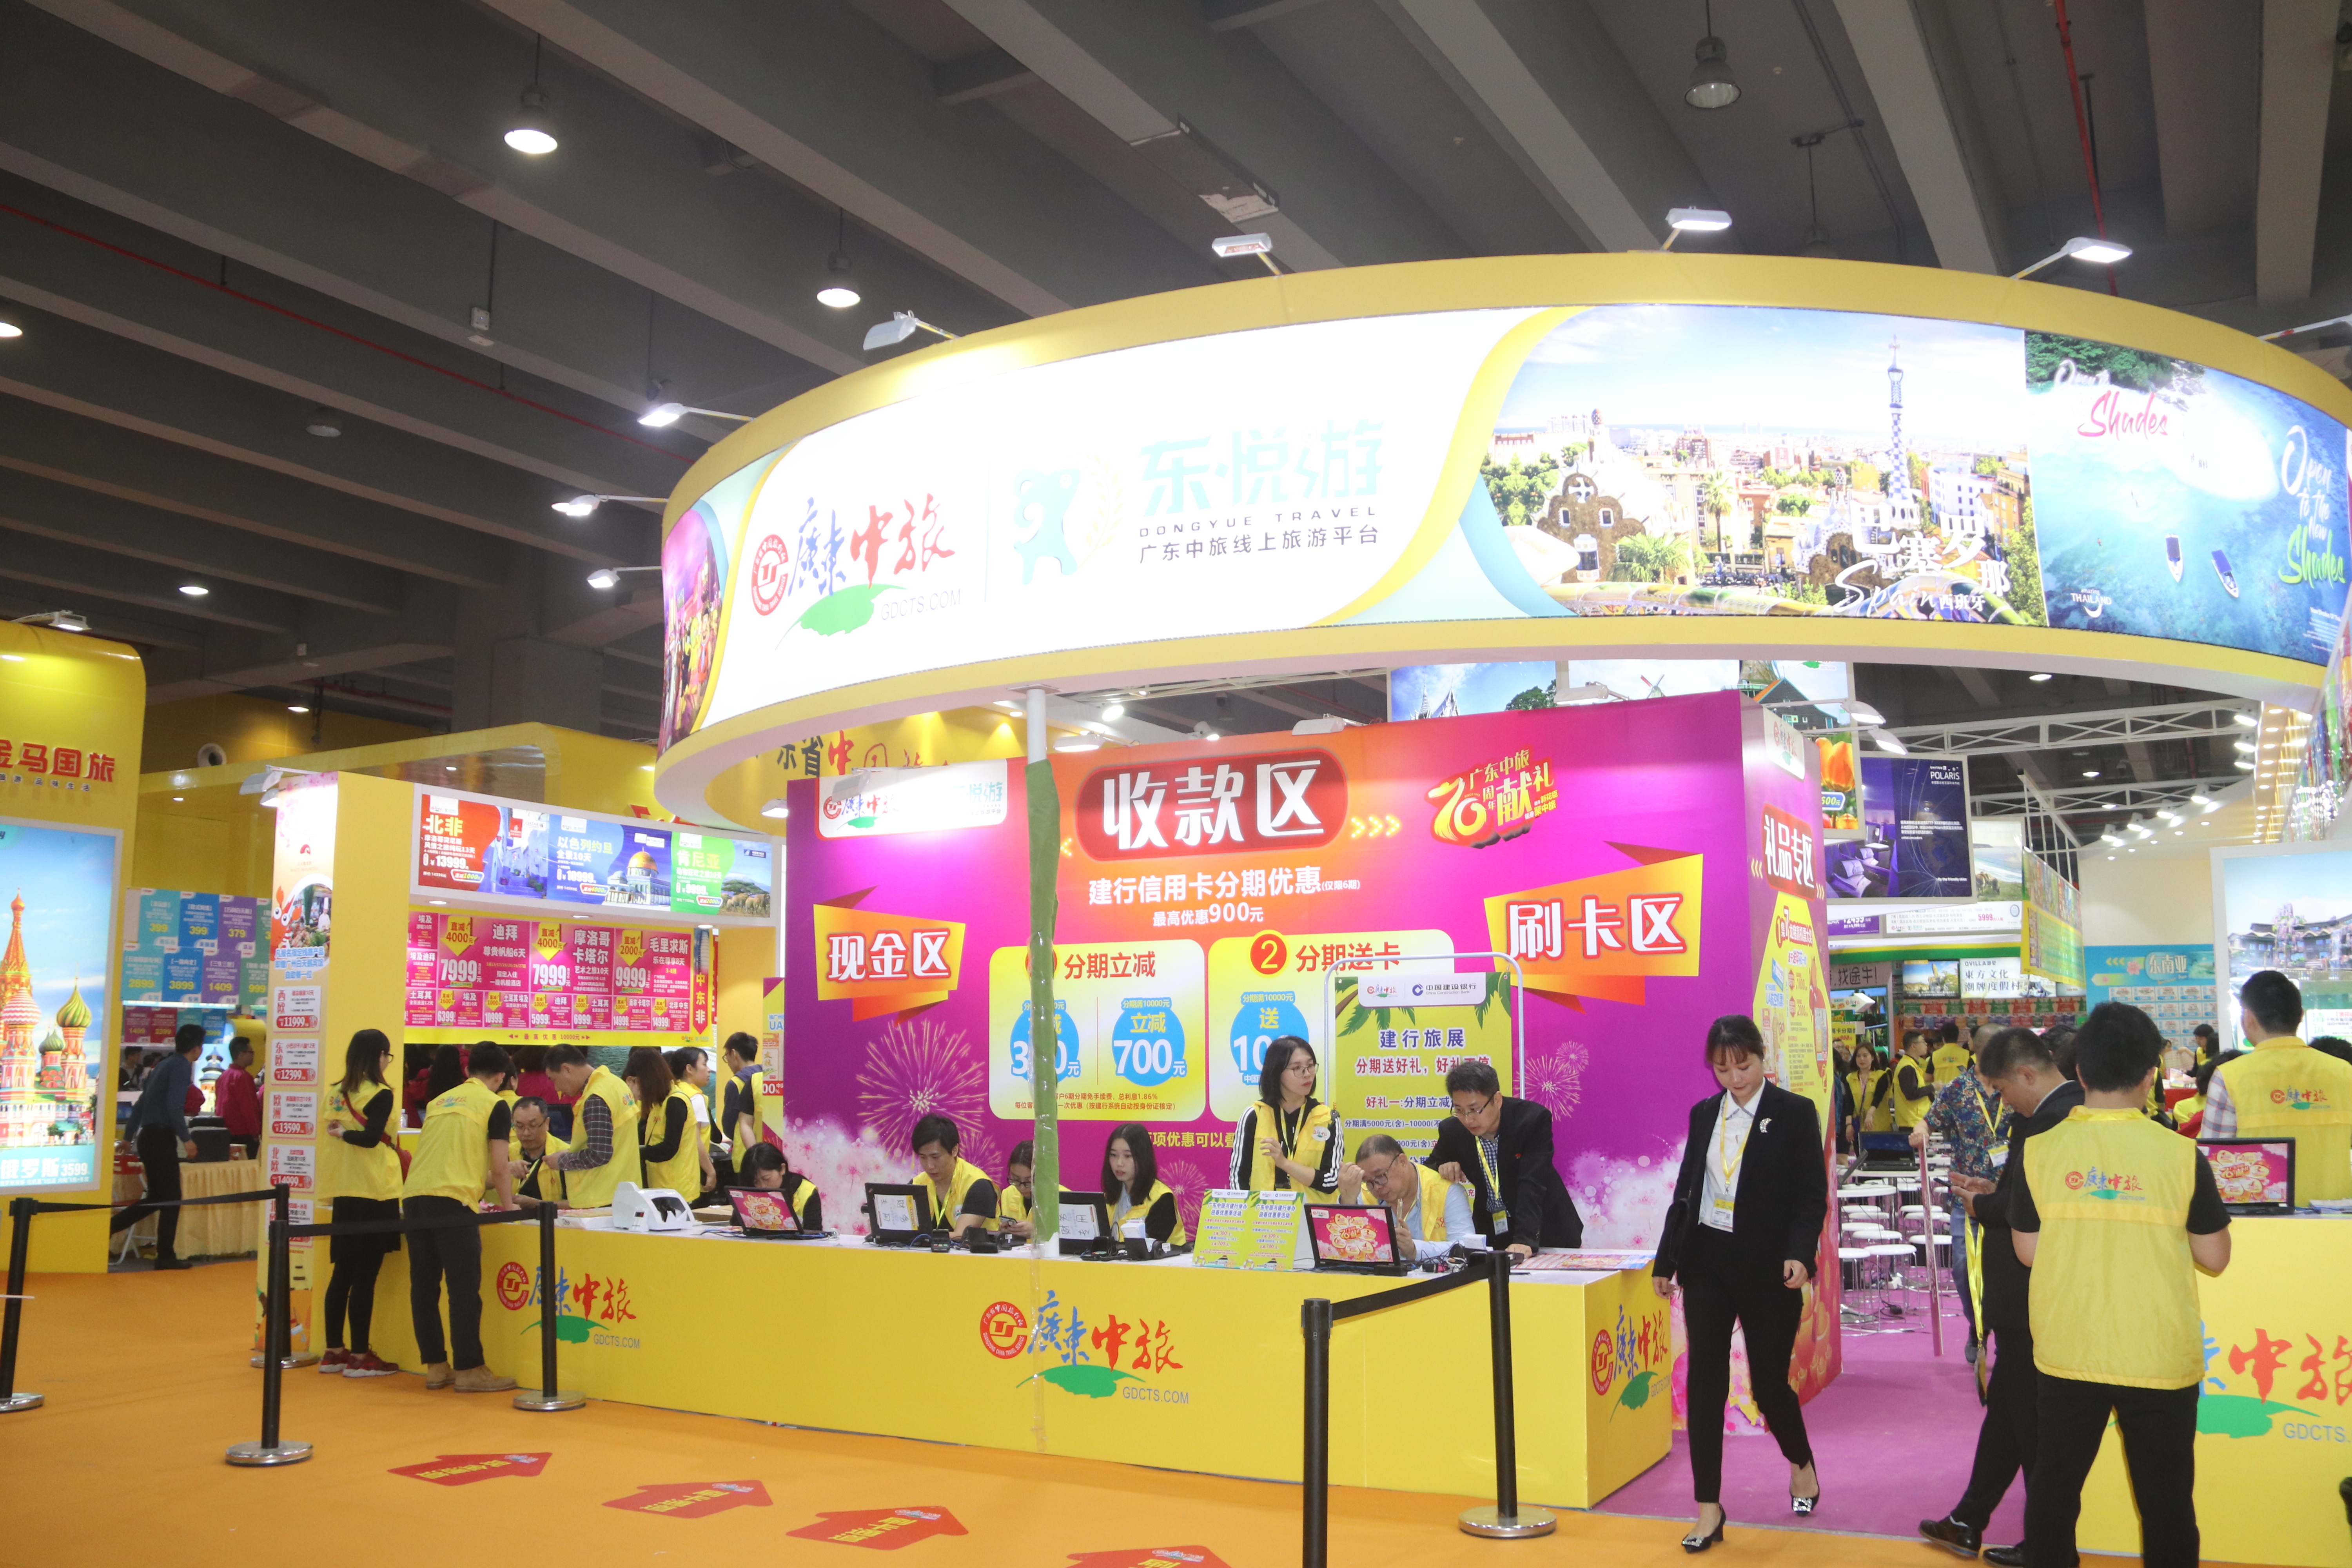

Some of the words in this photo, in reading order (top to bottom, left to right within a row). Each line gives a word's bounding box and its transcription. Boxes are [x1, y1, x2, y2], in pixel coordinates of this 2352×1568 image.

[2077, 390, 2168, 441] Shades
[2282, 425, 2332, 495] Open
[2296, 488, 2309, 520] to
[2312, 490, 2330, 523] the
[1140, 517, 1252, 537] DONGYUE
[1275, 506, 1376, 522] TRAVEL
[2309, 516, 2327, 541] New
[1140, 524, 1378, 563] 广东中旅线上旅游平台
[1851, 501, 2010, 596] 巴塞罗那
[2279, 524, 2346, 588] Shades
[1833, 559, 1937, 617] Spain
[1938, 594, 1985, 612] 西班牙
[881, 589, 961, 621] GDCTS.COM
[2071, 593, 2112, 605] THAILAND
[1470, 749, 1530, 790] 广东中旅
[1930, 771, 1960, 780] POLARIS
[953, 782, 1003, 803] 悦游
[1483, 785, 1496, 811] 周年
[1496, 762, 1554, 826] 献礼
[1103, 760, 1324, 850] 收款区
[1534, 800, 1556, 816] 聚中旅
[426, 815, 463, 836] 北非
[424, 834, 462, 845] 摩洛哥突尼斯
[424, 842, 475, 854] 风情之旅纯玩13天
[557, 836, 613, 854] 以色列约旦
[557, 850, 592, 862] 全景10天
[677, 849, 720, 869] 肯尼亚
[1764, 814, 1814, 889] 礼品专区
[676, 867, 722, 879] 动物狂欢之旅10天
[1089, 866, 1321, 906] 建行信用卡分期优惠
[1321, 878, 1361, 892] (仅限6期)
[418, 915, 432, 924] 埃及
[1152, 902, 1264, 927] 最高优惠900元
[149, 923, 169, 933] 399
[189, 926, 208, 935] 399
[228, 928, 246, 938] 379
[451, 922, 465, 931] 直减
[493, 924, 518, 941] 迪拜
[542, 928, 554, 937] 直减
[1509, 896, 1685, 959] 刷卡区
[446, 933, 474, 944] 4000元
[537, 938, 563, 949] 4000元
[574, 929, 610, 947] 摩洛哥
[624, 936, 636, 945] 直减
[650, 937, 689, 955] 毛里求斯
[275, 947, 325, 958] 凡报名指定线路产品
[410, 952, 436, 962] 埃及迪拜
[483, 946, 526, 958] 尊贵帆船6天
[572, 947, 609, 964] 卡塔尔
[620, 946, 642, 956] 2000元
[828, 931, 950, 980] 现金区
[1260, 940, 1279, 969] 2
[1296, 942, 1401, 973] 分期送卡
[653, 956, 685, 966] 乐在尊享8天
[1064, 951, 1156, 979] 分期立减
[2149, 955, 2188, 974] 东南亚
[285, 970, 312, 980] 自助餐一位
[575, 965, 609, 975] 艺术之旅10天
[1965, 970, 2009, 979] 東方文化
[128, 979, 155, 988] 2899
[169, 981, 194, 990] 3899
[209, 983, 233, 991] 1409
[248, 984, 267, 993] 999
[1965, 981, 2020, 991] 潮牌度假村
[277, 990, 286, 1014] 西欧
[410, 991, 432, 1000] 土耳其
[463, 992, 477, 1001] 埃及
[504, 994, 517, 1002] 土耳其
[554, 996, 567, 1005] 迪拜
[591, 999, 609, 1007] 土耳其
[695, 972, 706, 1024] 中东非
[1123, 999, 1170, 1009] 分期满10000元
[1243, 993, 1294, 1002] 分期满10000元
[284, 1016, 306, 1027] 11999
[1131, 1012, 1166, 1033] 立减
[1259, 1007, 1279, 1029] 送
[1380, 1029, 1464, 1048] 建行旅展
[275, 1042, 283, 1066] 东欧
[1012, 1041, 1080, 1075] 30元
[1113, 1040, 1186, 1076] 700元
[280, 1069, 303, 1080] 12399
[273, 1094, 281, 1119] 欧洲
[279, 1122, 301, 1134] 13599
[0, 1157, 60, 1179] 俄罗斯
[60, 1162, 88, 1176] 3599
[271, 1147, 280, 1172] 北欧
[593, 1334, 640, 1349] GDCTS.COM
[983, 1332, 996, 1352] GUANGDONG
[1005, 1347, 1016, 1356] TRAVEL
[1015, 1335, 1024, 1350] SERVICE
[1123, 1387, 1189, 1404] GDCTS.COM
[2283, 1423, 2352, 1443] GDCTS.
